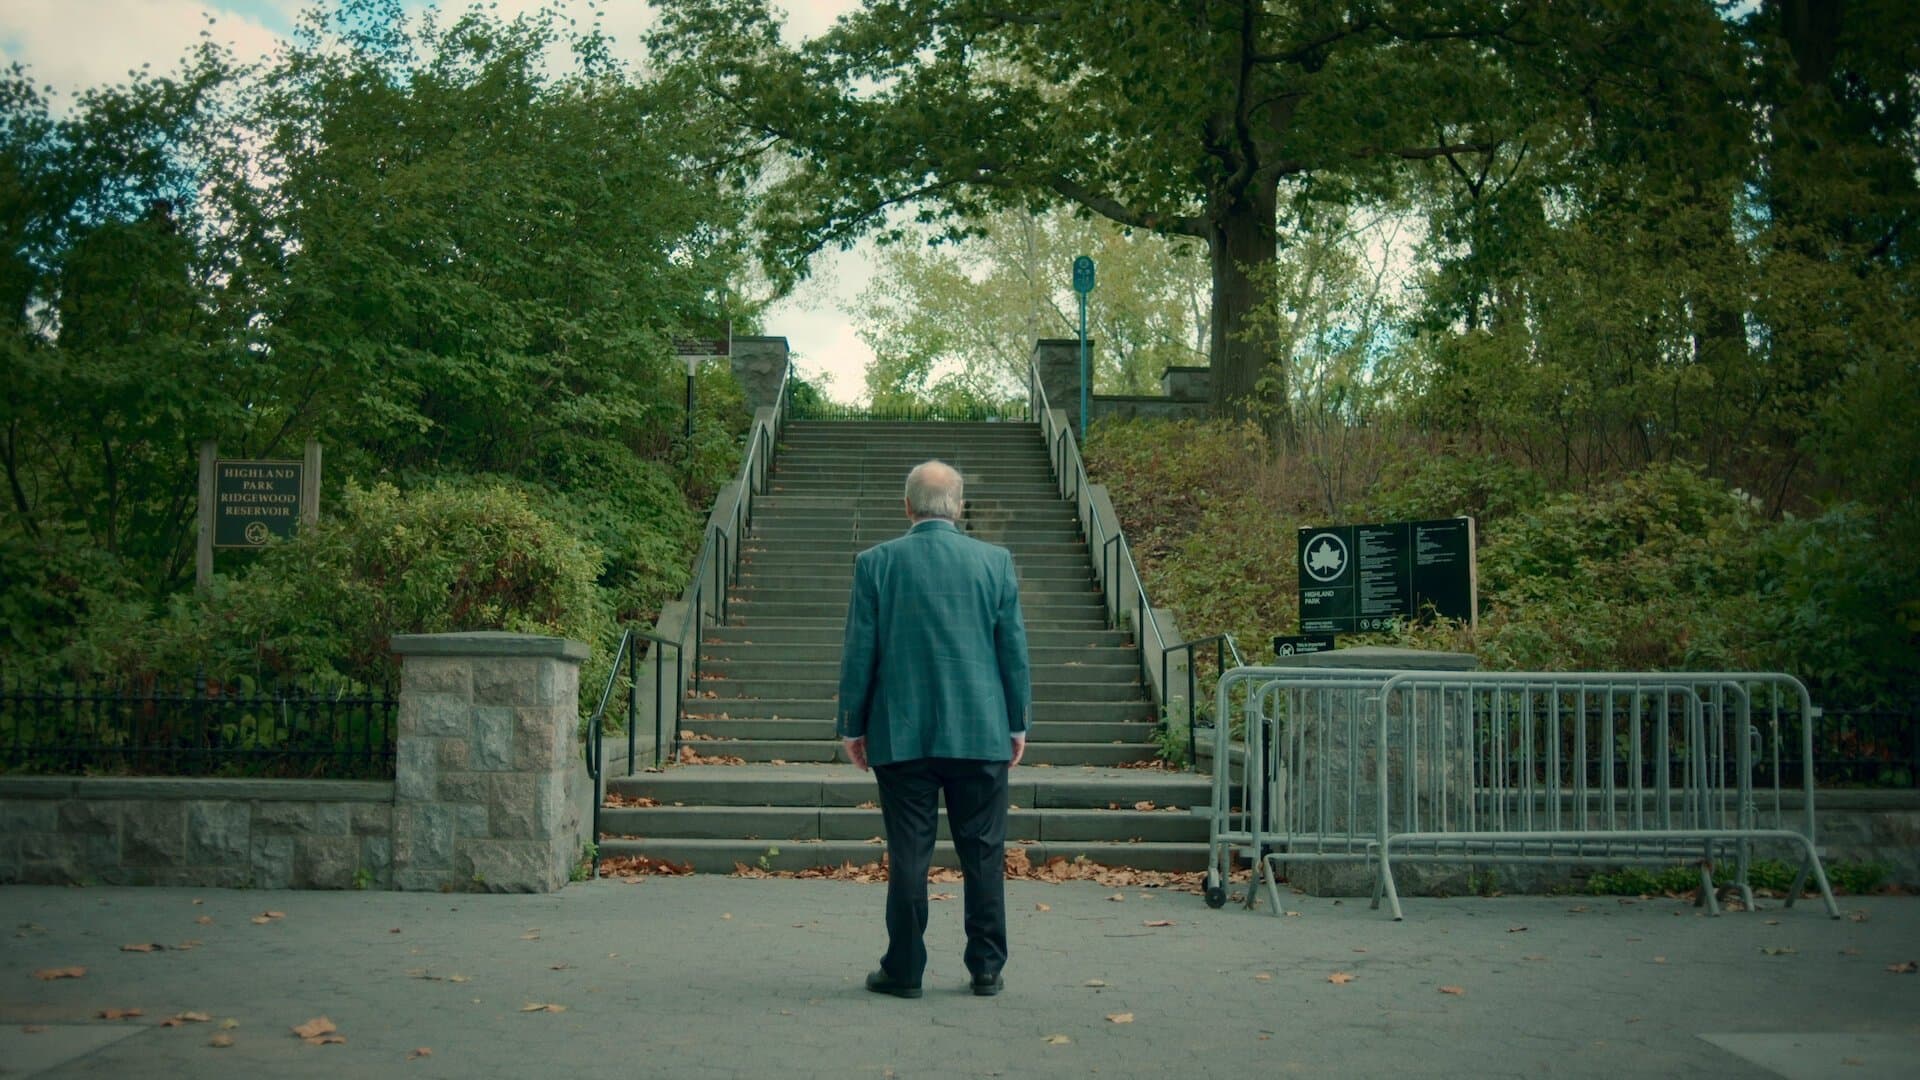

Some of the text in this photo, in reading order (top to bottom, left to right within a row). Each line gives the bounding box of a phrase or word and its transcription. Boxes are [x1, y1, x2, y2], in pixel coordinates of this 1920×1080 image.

[224, 468, 295, 478] HIGHLAND
[243, 481, 274, 490] PARK
[221, 493, 297, 503] RIDGEWOOD
[225, 506, 290, 516] RESERVOIR
[1304, 590, 1335, 598] HIGHLAND
